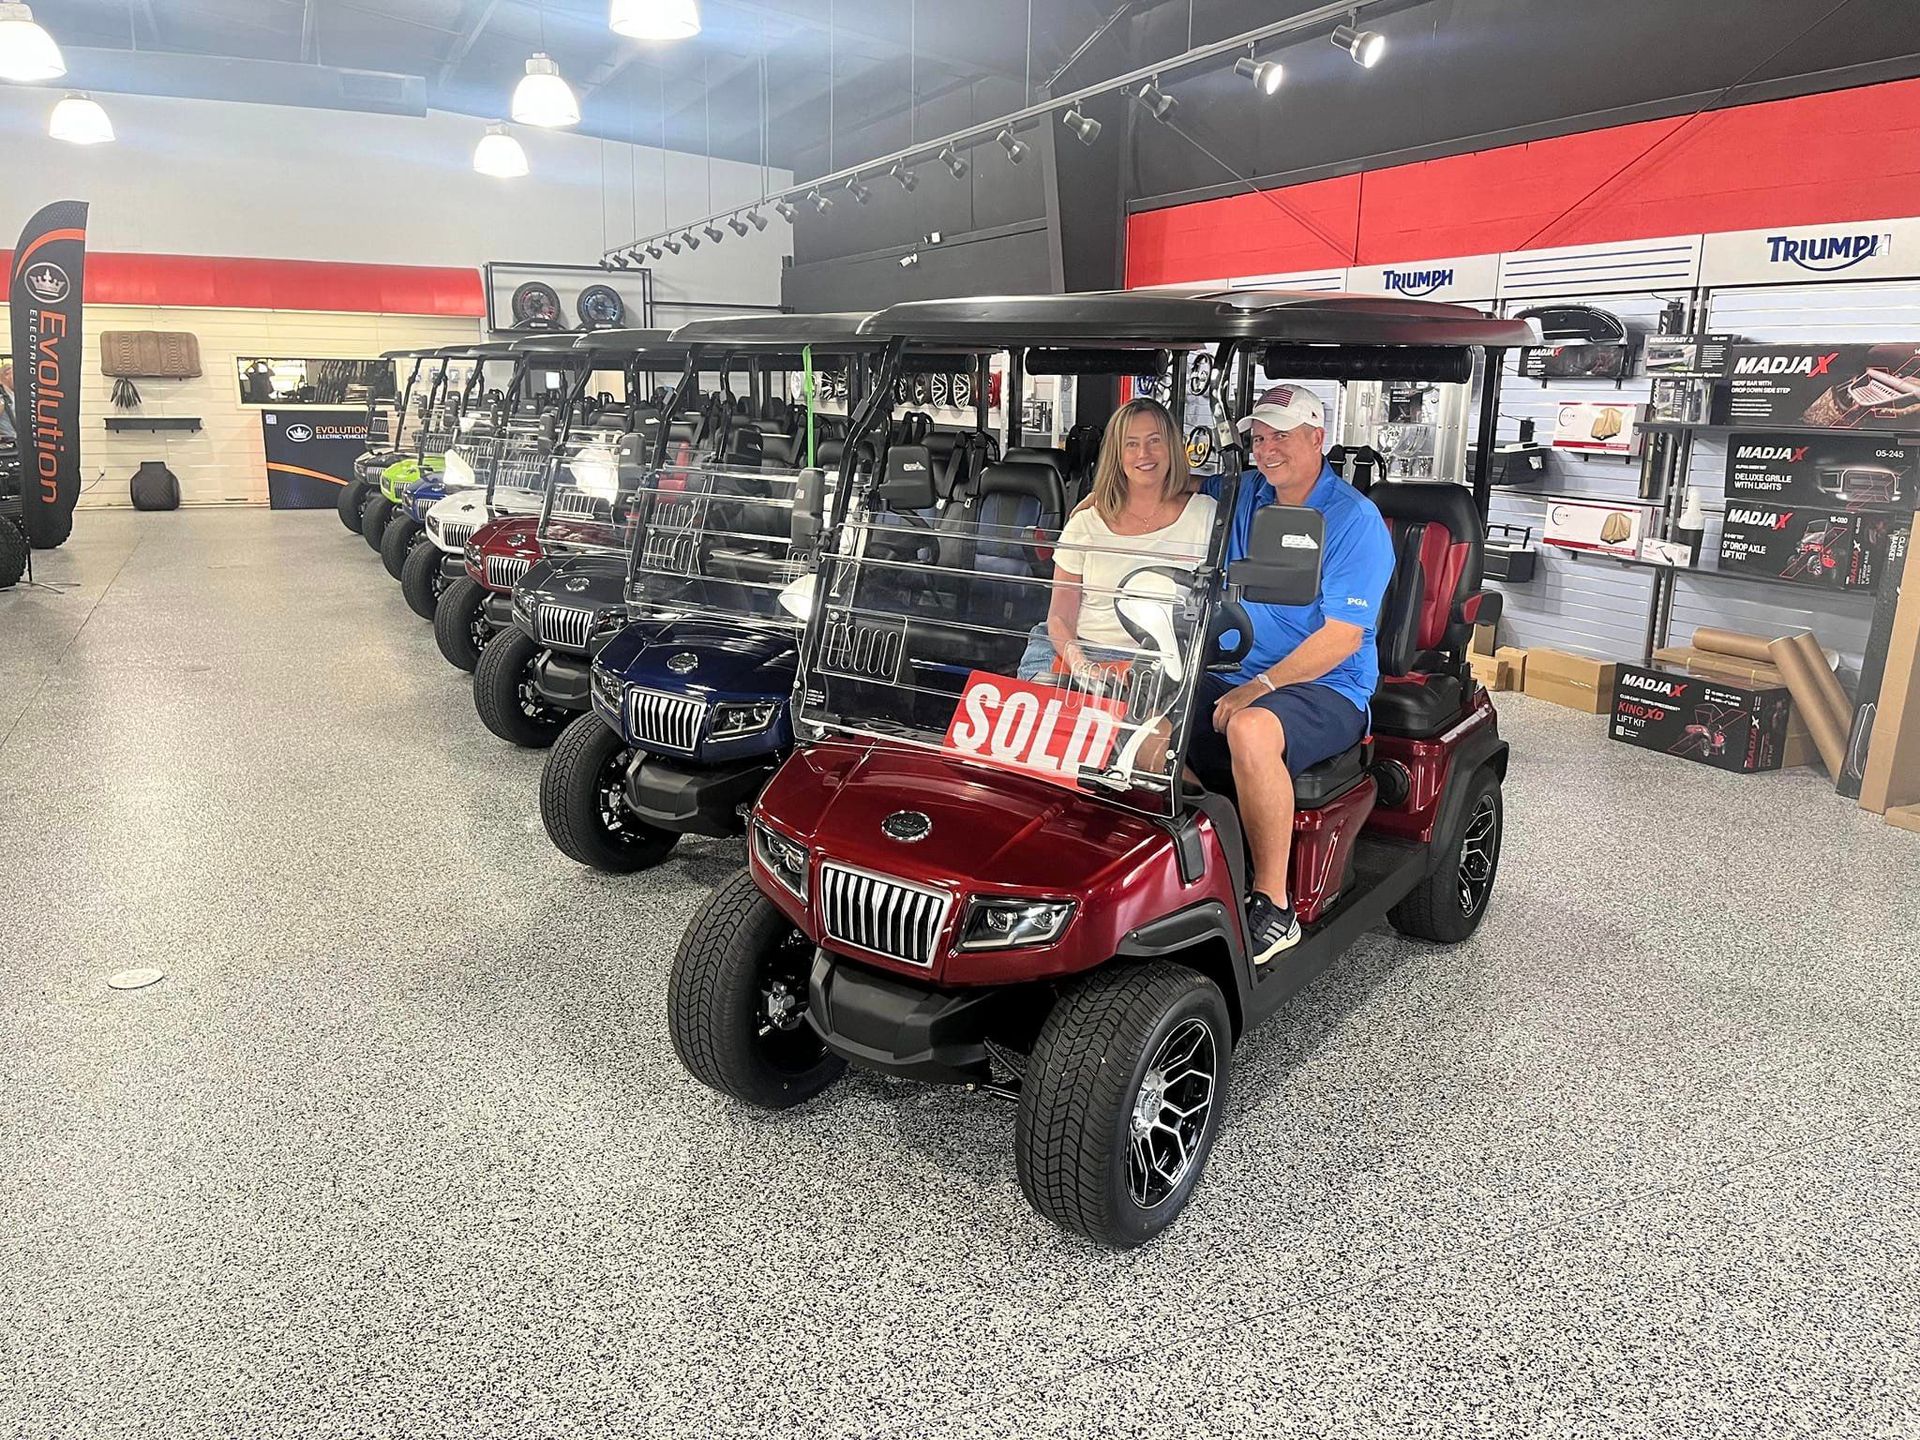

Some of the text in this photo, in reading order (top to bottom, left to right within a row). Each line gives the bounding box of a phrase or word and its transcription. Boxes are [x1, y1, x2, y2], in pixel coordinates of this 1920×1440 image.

[1766, 233, 1892, 271] TRIUMPH
[1383, 269, 1453, 297] TRIUMPH
[29, 309, 38, 375] ELECTRIC
[1528, 347, 1564, 357] MADJAX
[1733, 352, 1840, 378] MADJAX
[36, 309, 67, 504] Evolution
[315, 425, 368, 434] EVOLUTION
[1736, 446, 1810, 463] MADJAX
[1875, 449, 1904, 459] 05-245
[1734, 473, 1792, 483] DELUXE GRILLE
[1734, 481, 1782, 491] WITH LIGHTS
[1727, 508, 1793, 531] MADJAX
[1721, 549, 1747, 561] LIFT KIT
[1730, 541, 1748, 551] DROP
[1748, 543, 1767, 555] AXLE
[1850, 539, 1861, 584] MADJAX
[1347, 597, 1368, 608] PGA
[1621, 673, 1688, 698] MADJAX
[1616, 714, 1646, 728] LIFT KIT
[1617, 701, 1665, 721] KING XD
[951, 683, 1113, 771] SOLD
[1747, 715, 1760, 768] MADJAX
